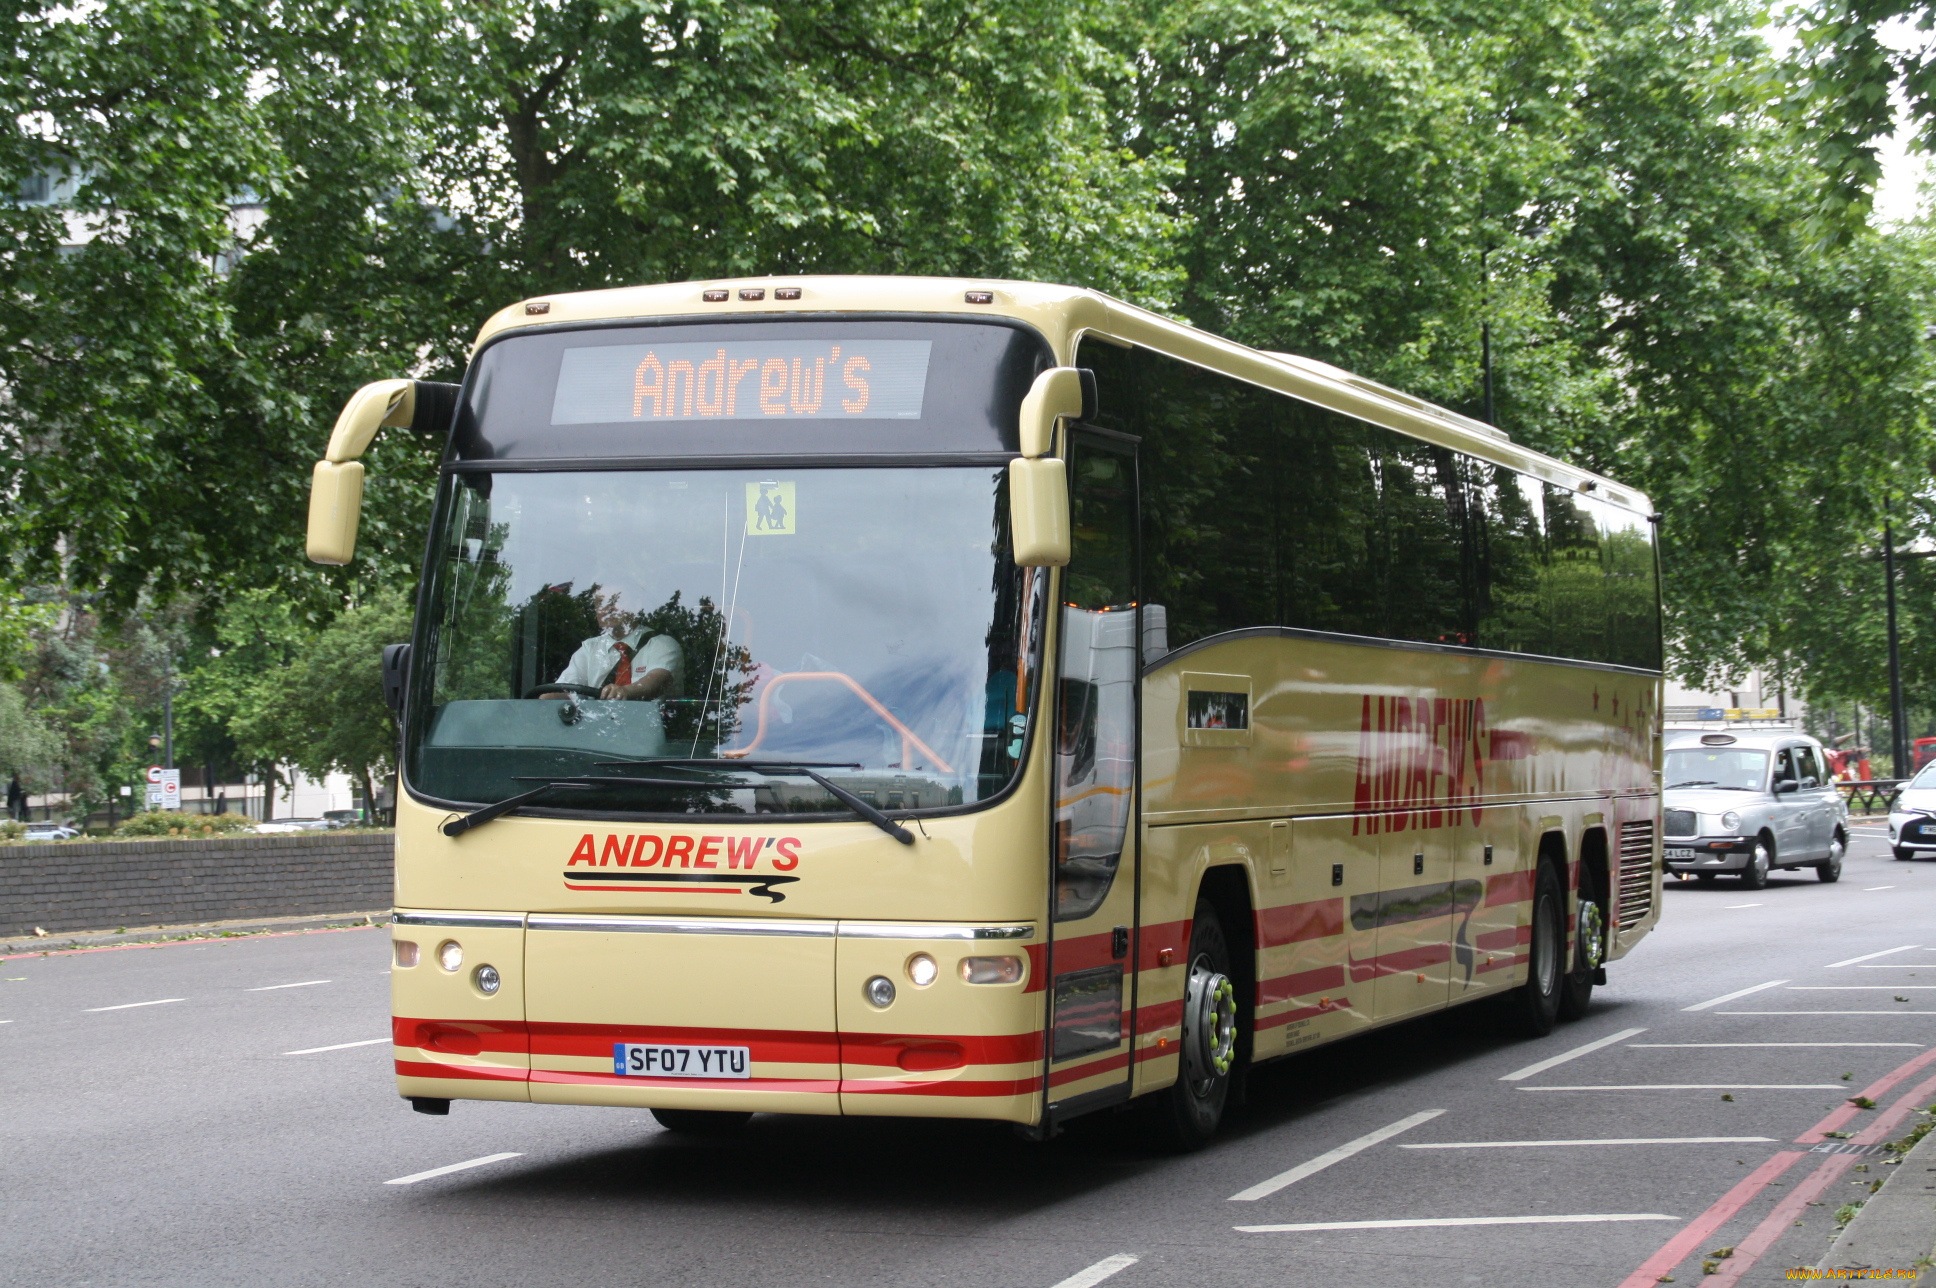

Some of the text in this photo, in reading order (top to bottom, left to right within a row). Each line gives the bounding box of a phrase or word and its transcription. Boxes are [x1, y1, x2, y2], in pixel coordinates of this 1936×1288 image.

[633, 346, 871, 417] Andrew's
[1352, 695, 1486, 836] ANDREW'S
[567, 833, 802, 871] ANDREW'S
[1674, 849, 1691, 857] LCZ
[630, 1047, 745, 1073] SF07 YTU
